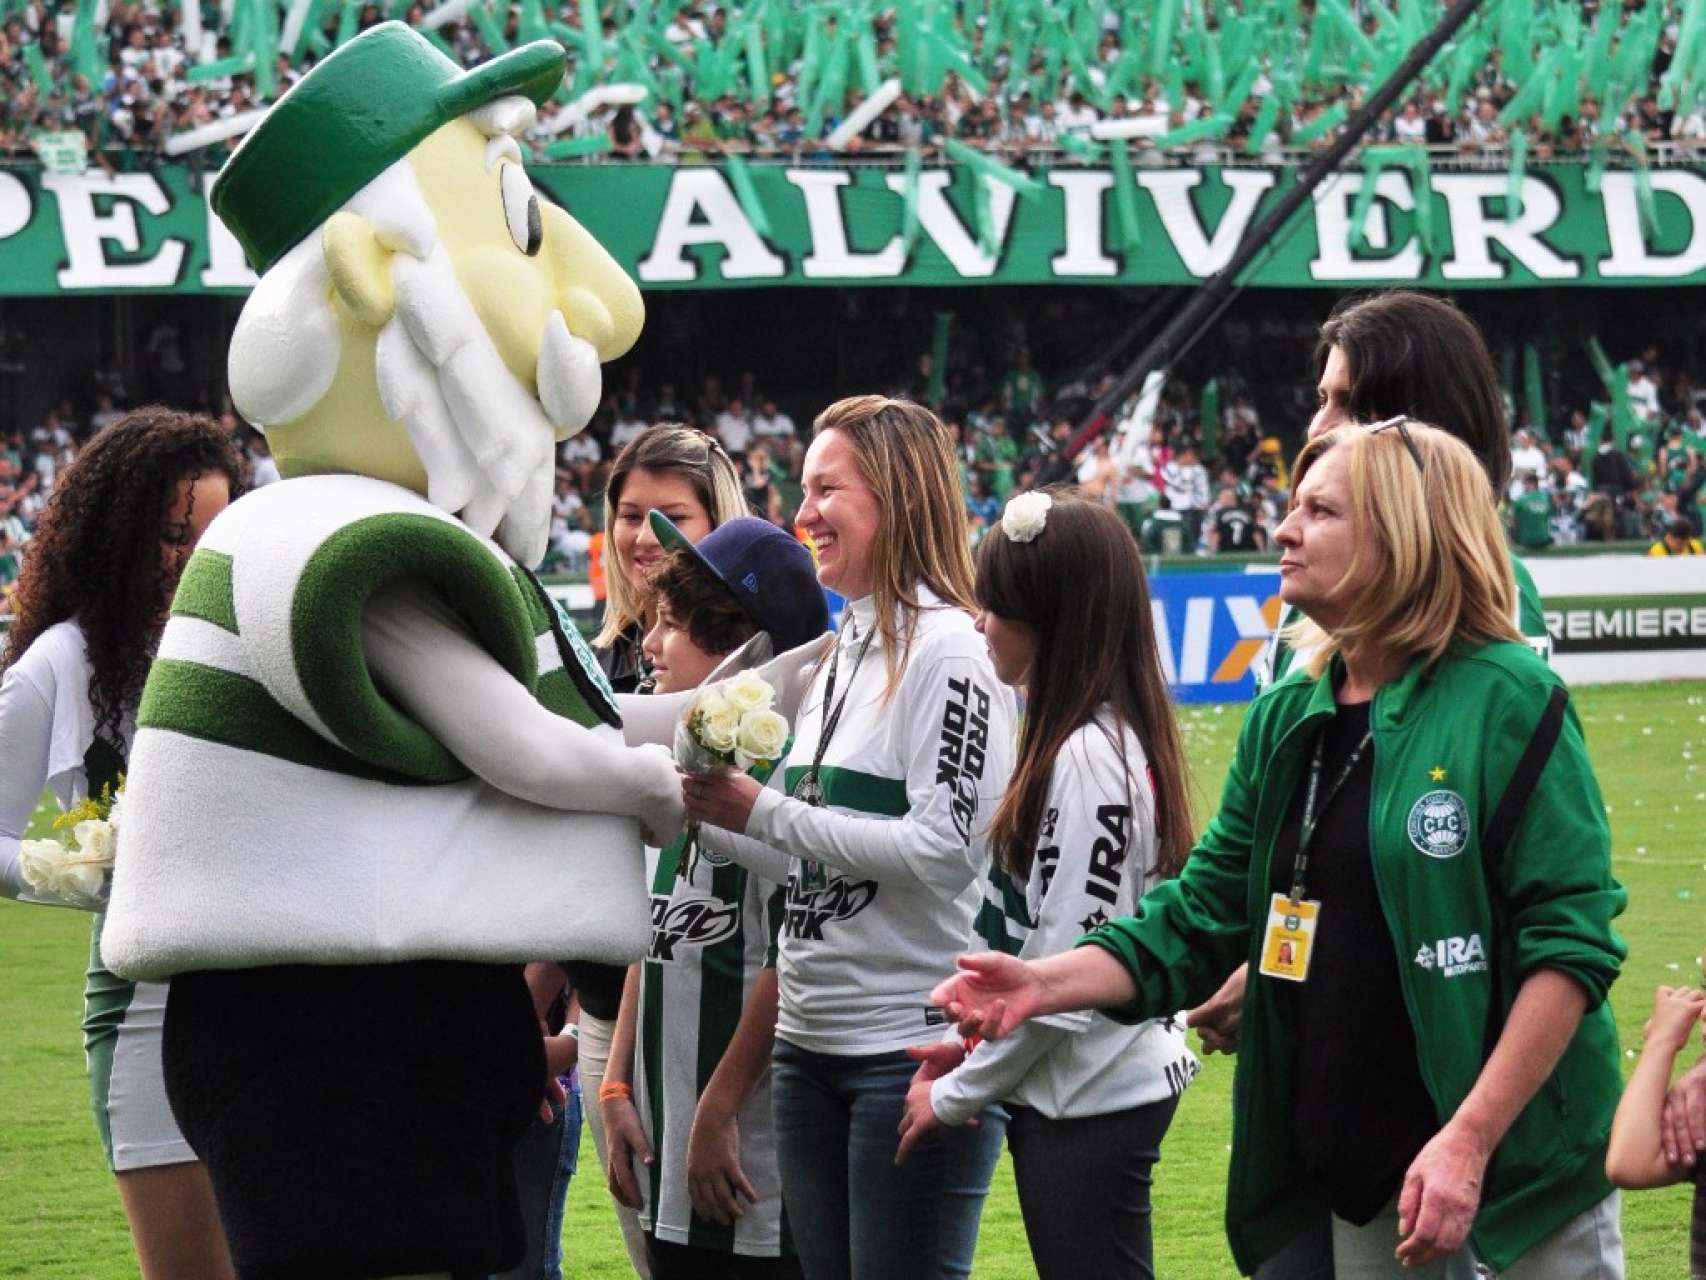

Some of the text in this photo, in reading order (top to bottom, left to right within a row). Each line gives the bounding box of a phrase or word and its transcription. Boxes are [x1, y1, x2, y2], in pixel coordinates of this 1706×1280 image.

[936, 677, 970, 794] TORK
[964, 684, 990, 781] PRO
[1085, 805, 1131, 906] IRA
[1437, 933, 1486, 968] IRA
